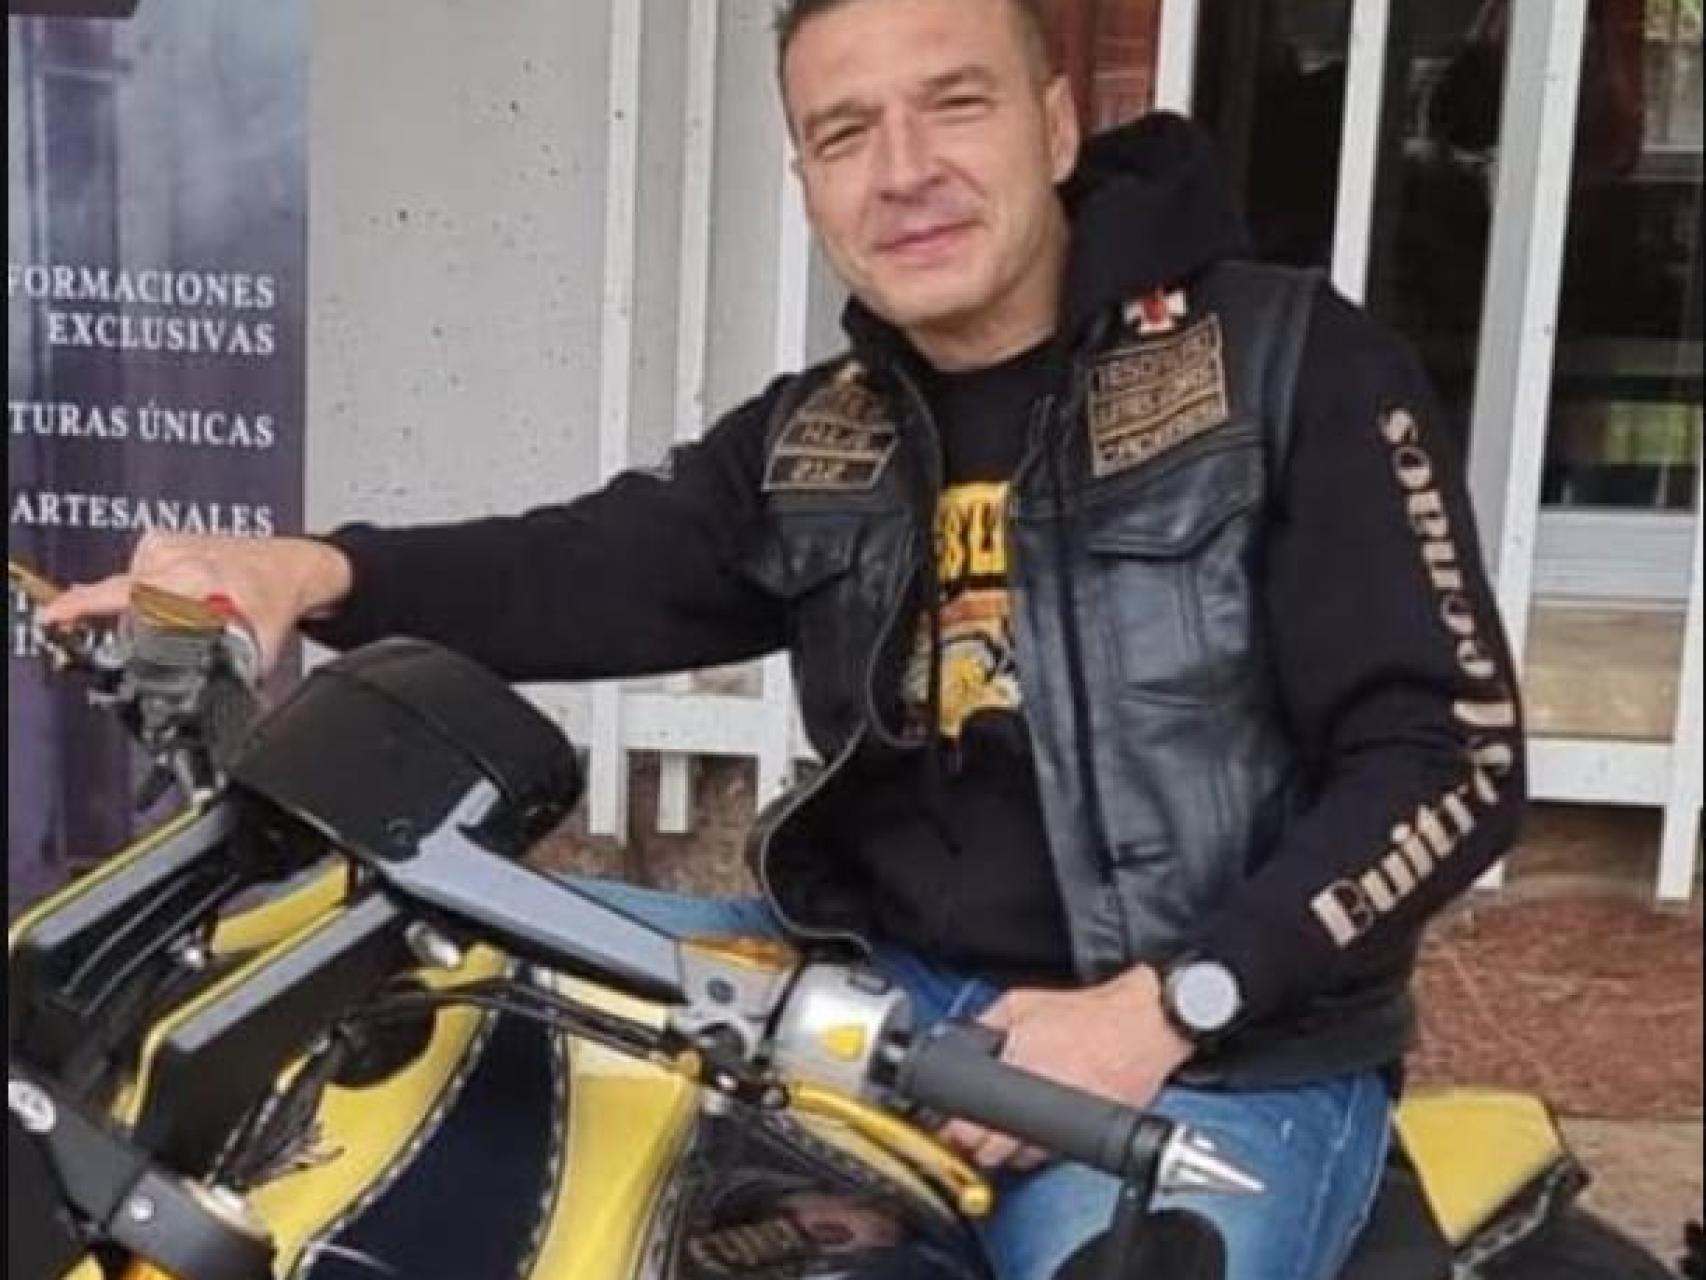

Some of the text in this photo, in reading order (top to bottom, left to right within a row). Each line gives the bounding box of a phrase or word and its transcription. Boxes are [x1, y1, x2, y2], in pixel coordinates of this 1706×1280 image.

[50, 312, 275, 355] EXCLUSIVAS
[8, 400, 275, 448] TURAS ÚNICAS
[10, 491, 273, 537] ARTESANALES
